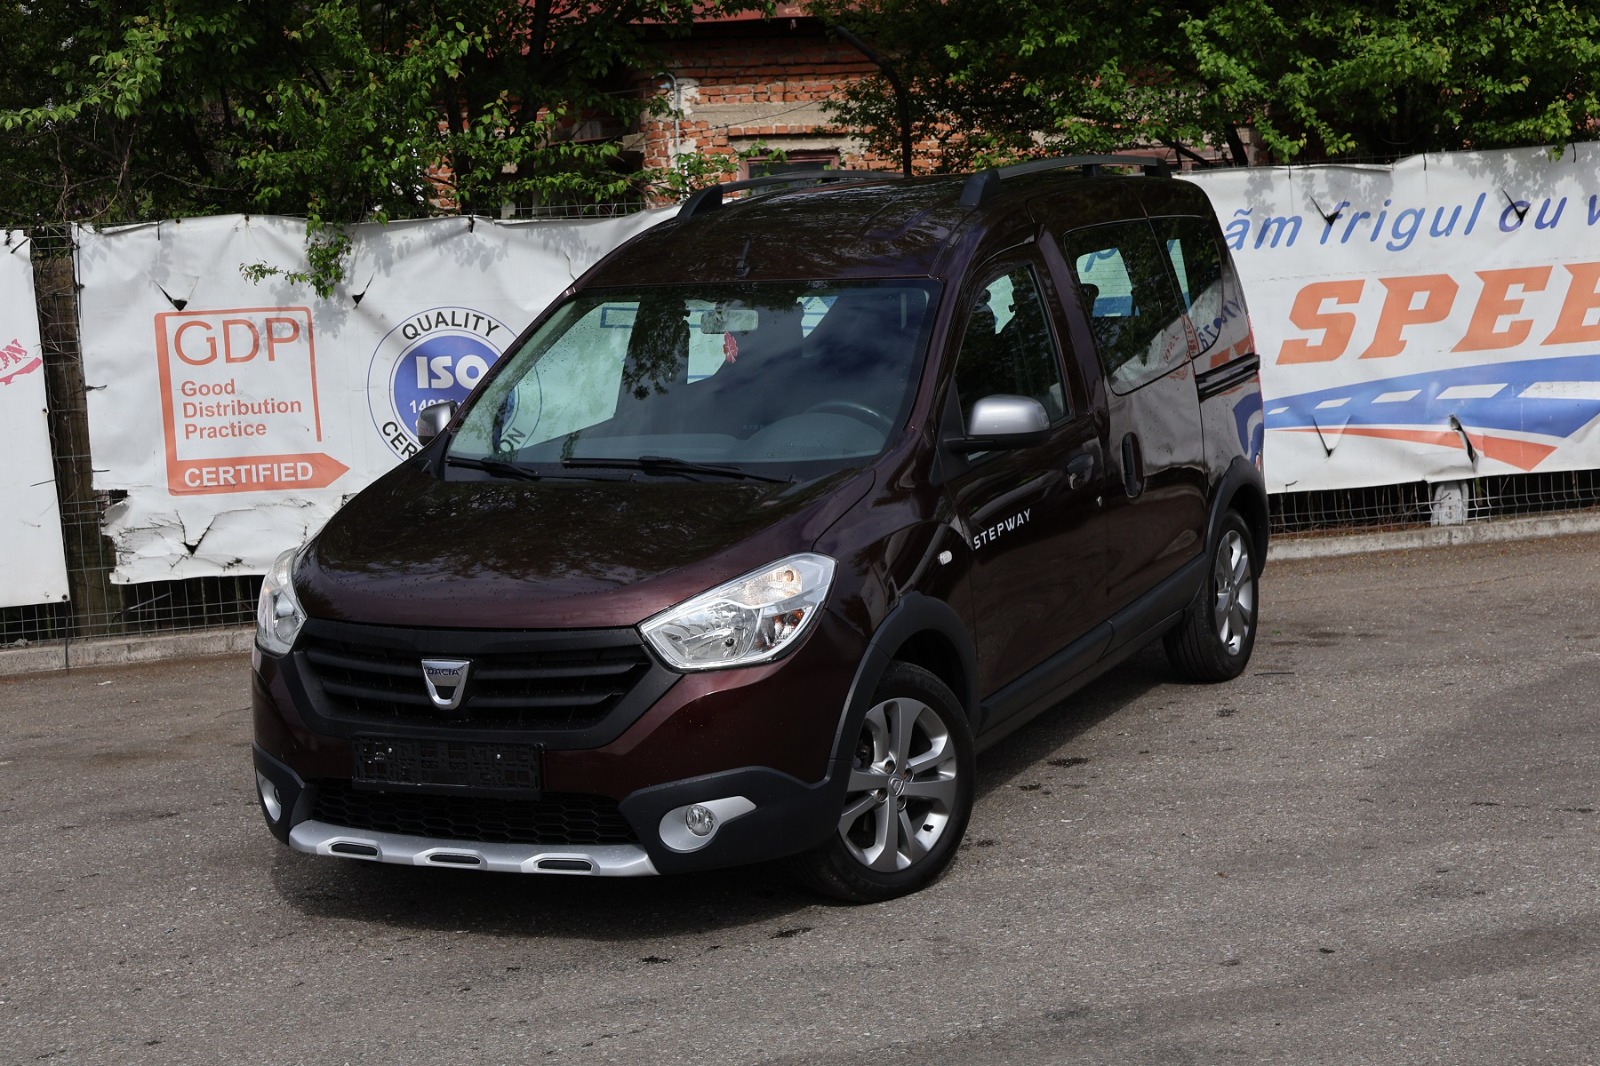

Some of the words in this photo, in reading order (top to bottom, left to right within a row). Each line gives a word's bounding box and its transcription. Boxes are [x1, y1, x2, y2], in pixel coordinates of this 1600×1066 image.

[1319, 191, 1487, 252] frigul
[402, 310, 500, 340] QUALITY
[173, 317, 300, 366] GDP
[415, 354, 490, 390] ISO
[180, 378, 236, 397] Good
[182, 397, 302, 419] Distribution
[184, 421, 267, 440] Practice
[184, 462, 313, 487] CERTIFIED
[973, 508, 1031, 549] STEPWAY
[427, 668, 460, 676] DACIA
